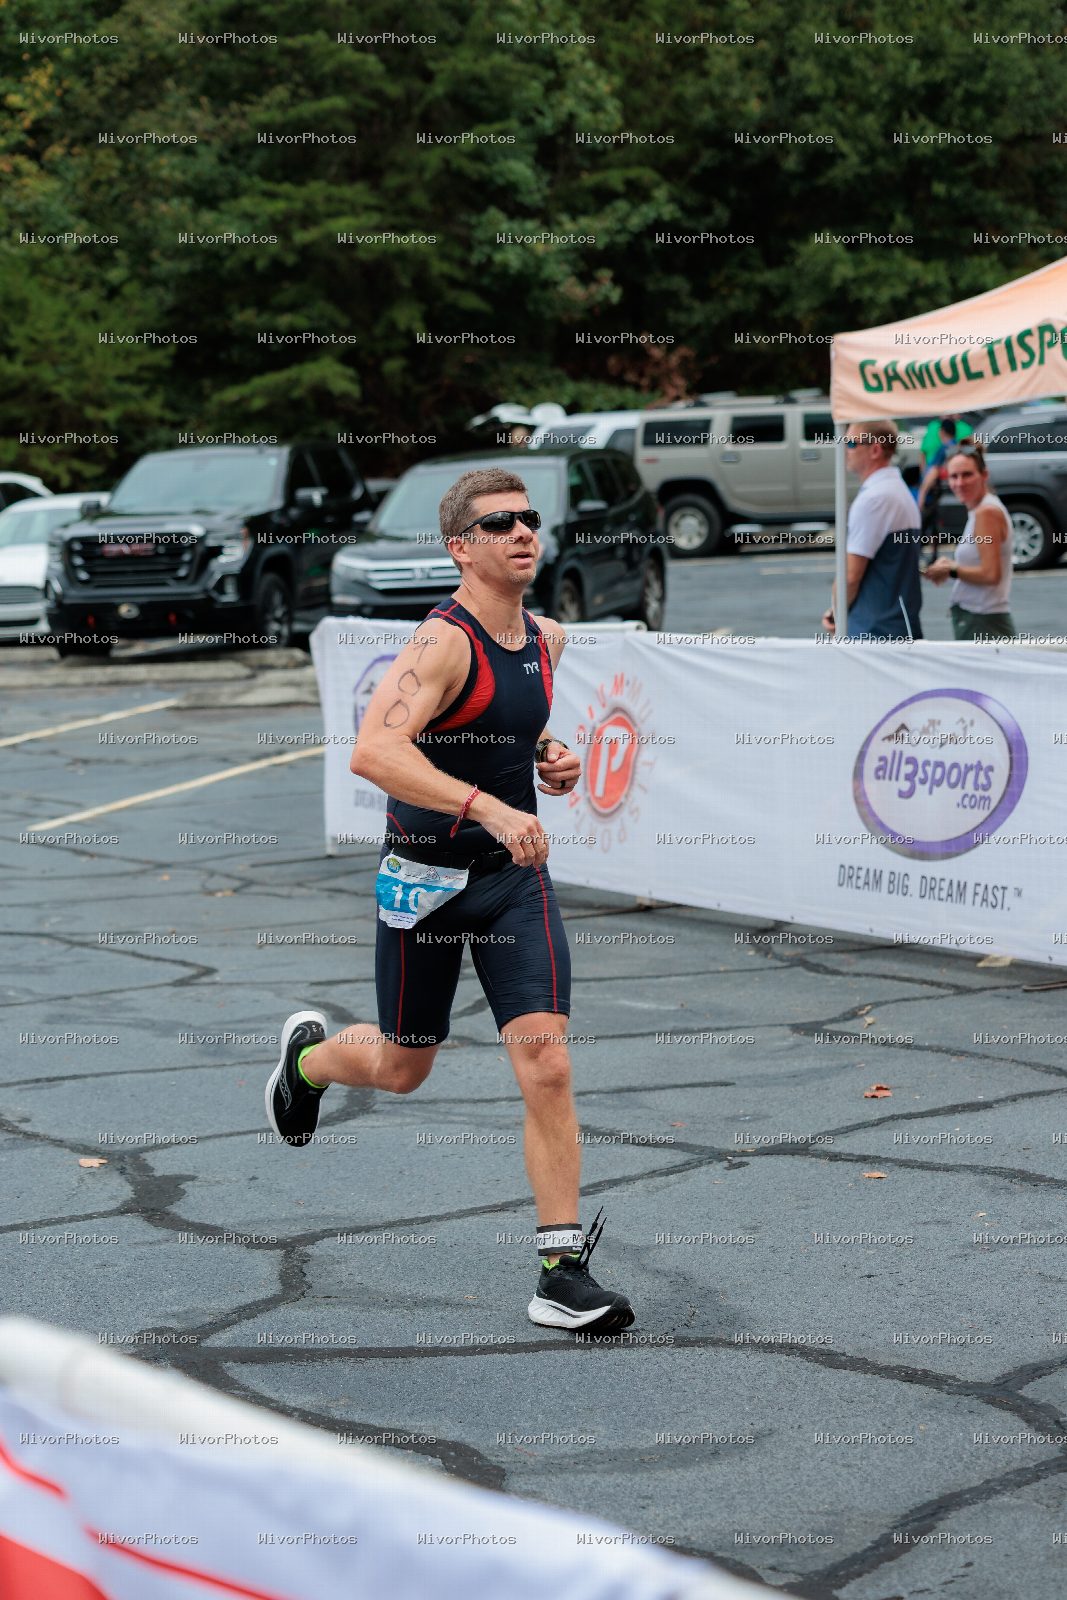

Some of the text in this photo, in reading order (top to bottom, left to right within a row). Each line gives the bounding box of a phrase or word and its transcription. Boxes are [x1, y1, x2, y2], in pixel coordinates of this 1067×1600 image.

[523, 661, 540, 675] TYR
[873, 749, 994, 799] all3sports
[956, 793, 992, 811] .com
[837, 863, 884, 893] DREAM
[886, 871, 914, 898] BIG.
[919, 875, 967, 905] DREAM
